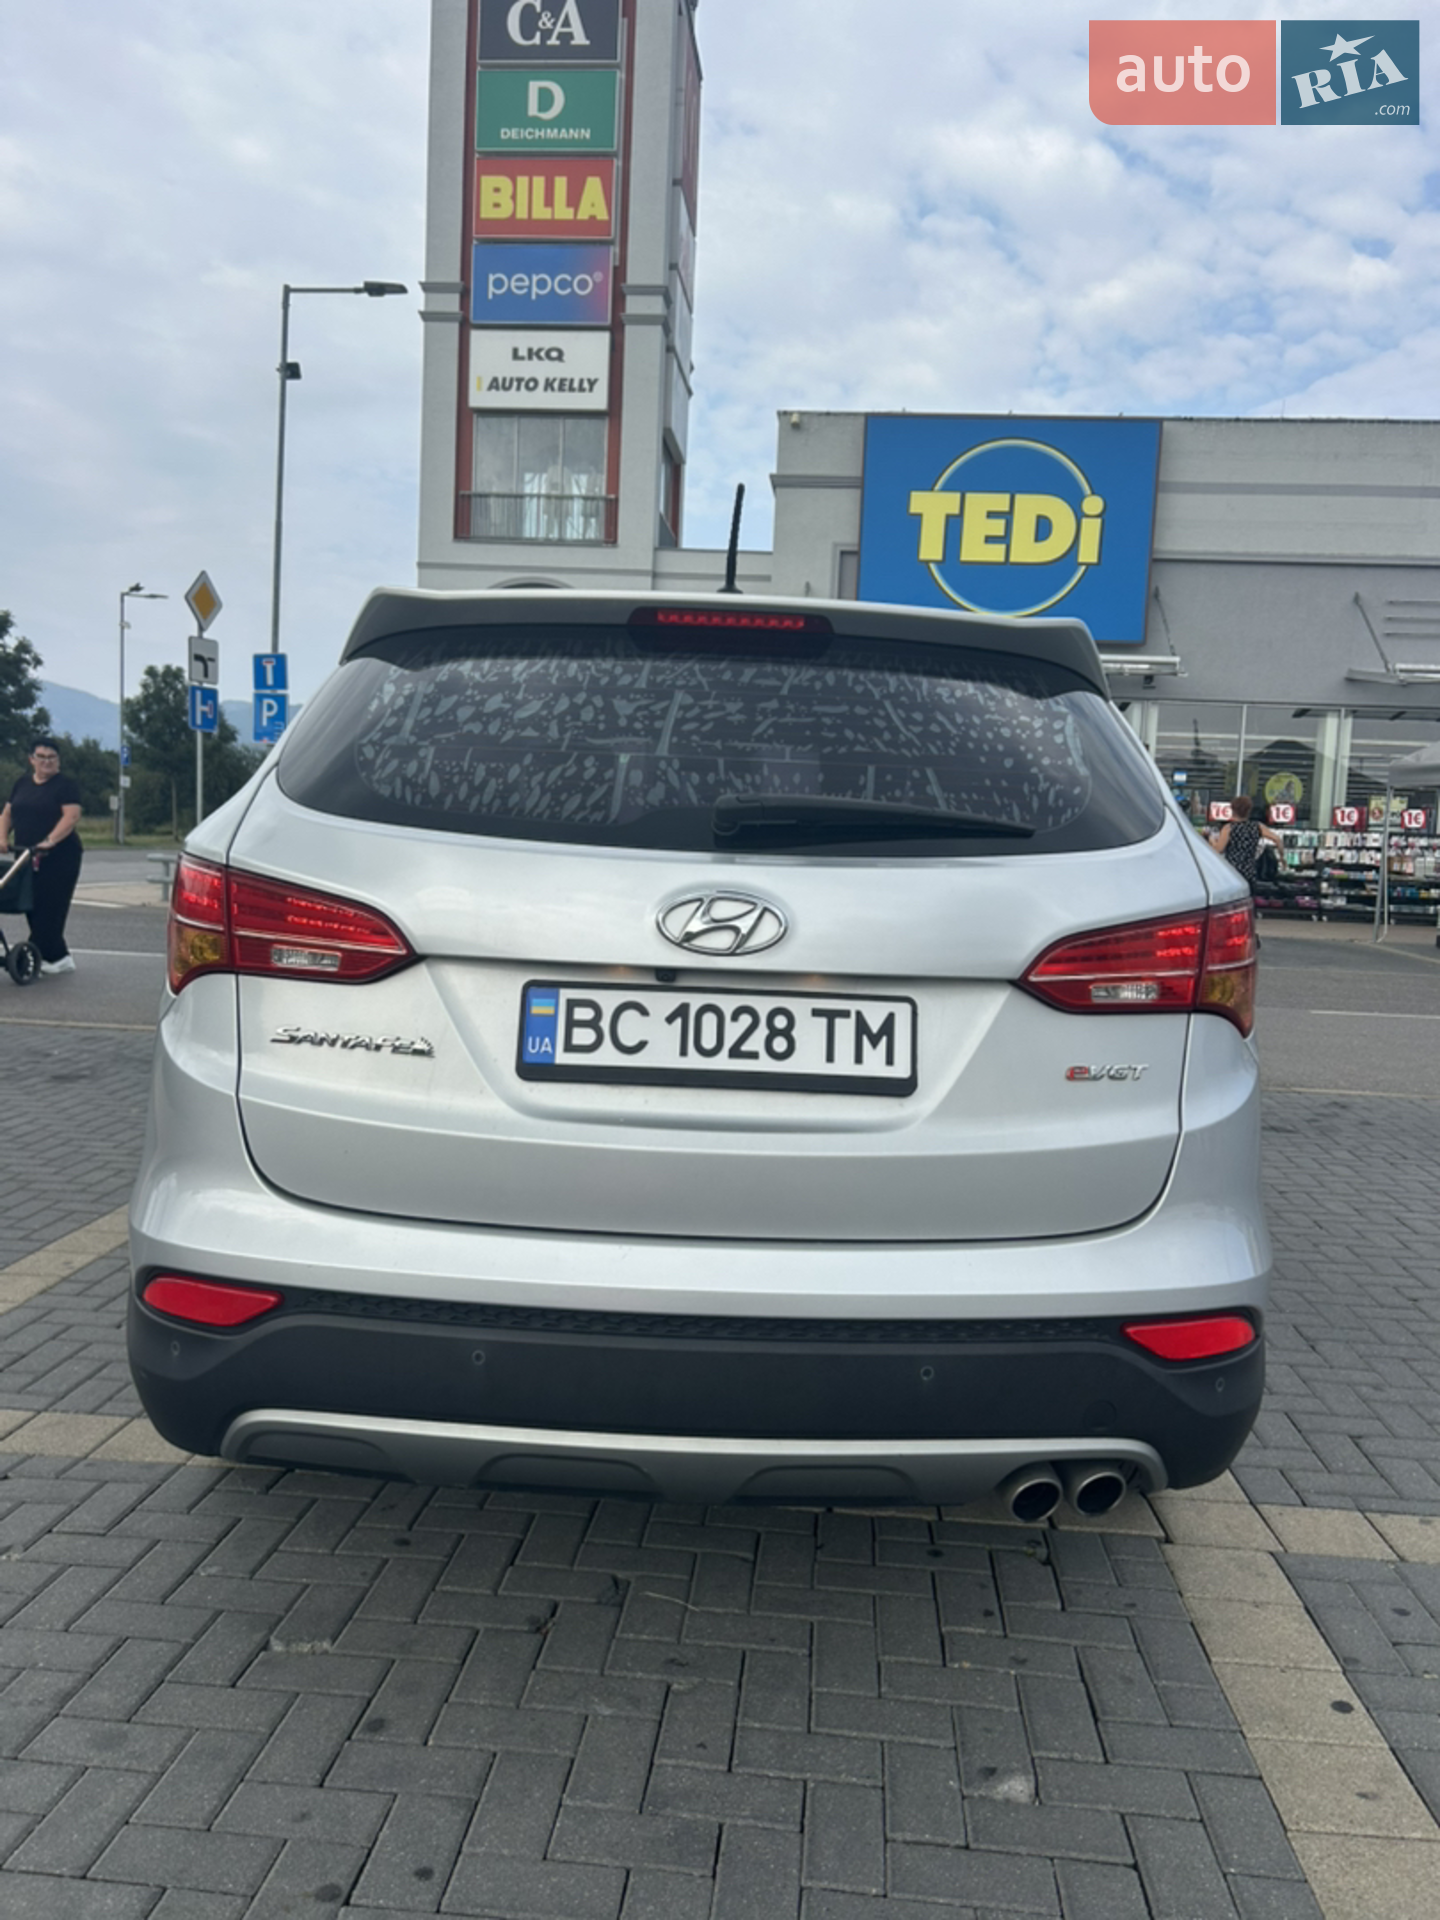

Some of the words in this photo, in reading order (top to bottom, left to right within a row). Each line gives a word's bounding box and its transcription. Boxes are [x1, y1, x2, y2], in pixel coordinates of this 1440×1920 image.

[506, 0, 591, 46] C&A
[526, 80, 566, 120] D
[500, 127, 591, 141] DEICHMANN
[479, 175, 609, 220] BILLA
[511, 347, 566, 363] LKQ
[487, 377, 539, 392] AUTO
[543, 377, 599, 393] KELLY
[908, 490, 1106, 565] TEDi
[262, 698, 278, 726] P
[1275, 805, 1290, 820] 1€
[1407, 811, 1422, 825] 1€
[562, 997, 650, 1055] BC
[664, 1001, 796, 1062] 1028
[811, 1007, 895, 1067] TM
[527, 1036, 553, 1054] UA
